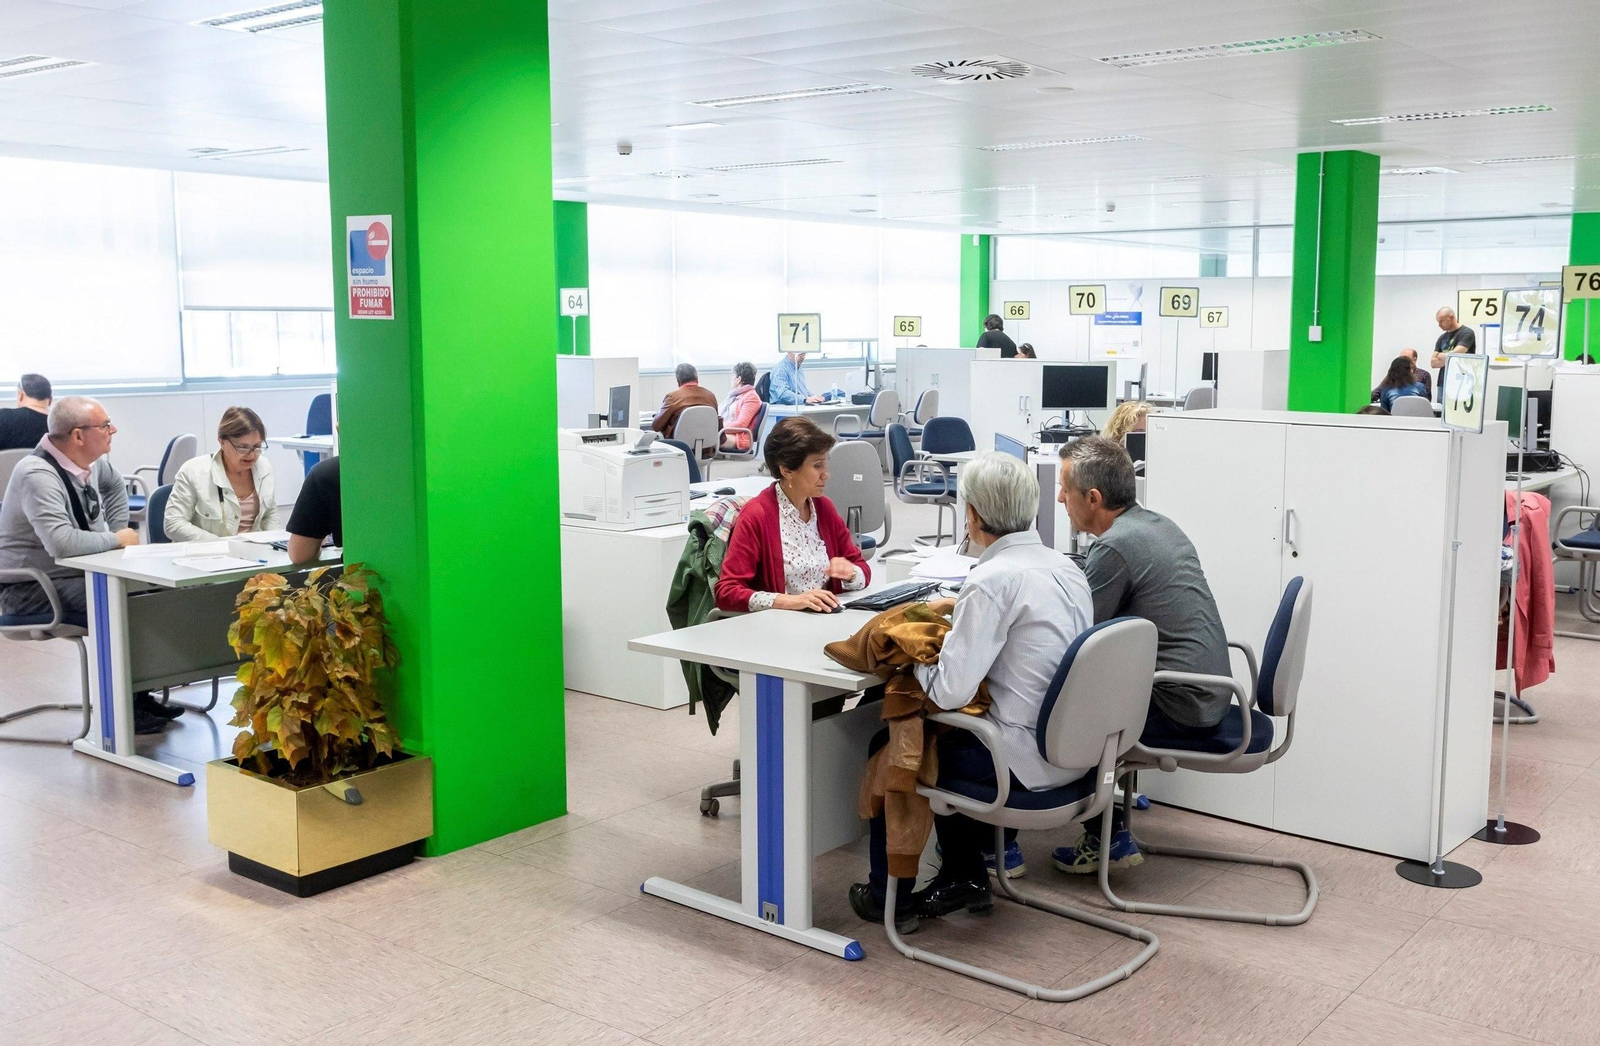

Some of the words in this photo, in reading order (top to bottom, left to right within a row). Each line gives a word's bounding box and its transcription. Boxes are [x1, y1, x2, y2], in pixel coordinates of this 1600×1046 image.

[352, 267, 374, 275] espacio
[1574, 272, 1600, 291] 76
[352, 288, 390, 298] PROHIBIDO
[1076, 292, 1096, 308] 70
[360, 298, 383, 308] FUMAR
[568, 294, 583, 309] 64
[1171, 294, 1192, 310] 69
[1470, 298, 1498, 317] 75
[1010, 305, 1025, 316] 66
[1207, 311, 1223, 323] 67
[900, 321, 915, 332] 65
[1515, 304, 1546, 341] 74
[789, 322, 810, 343] 71
